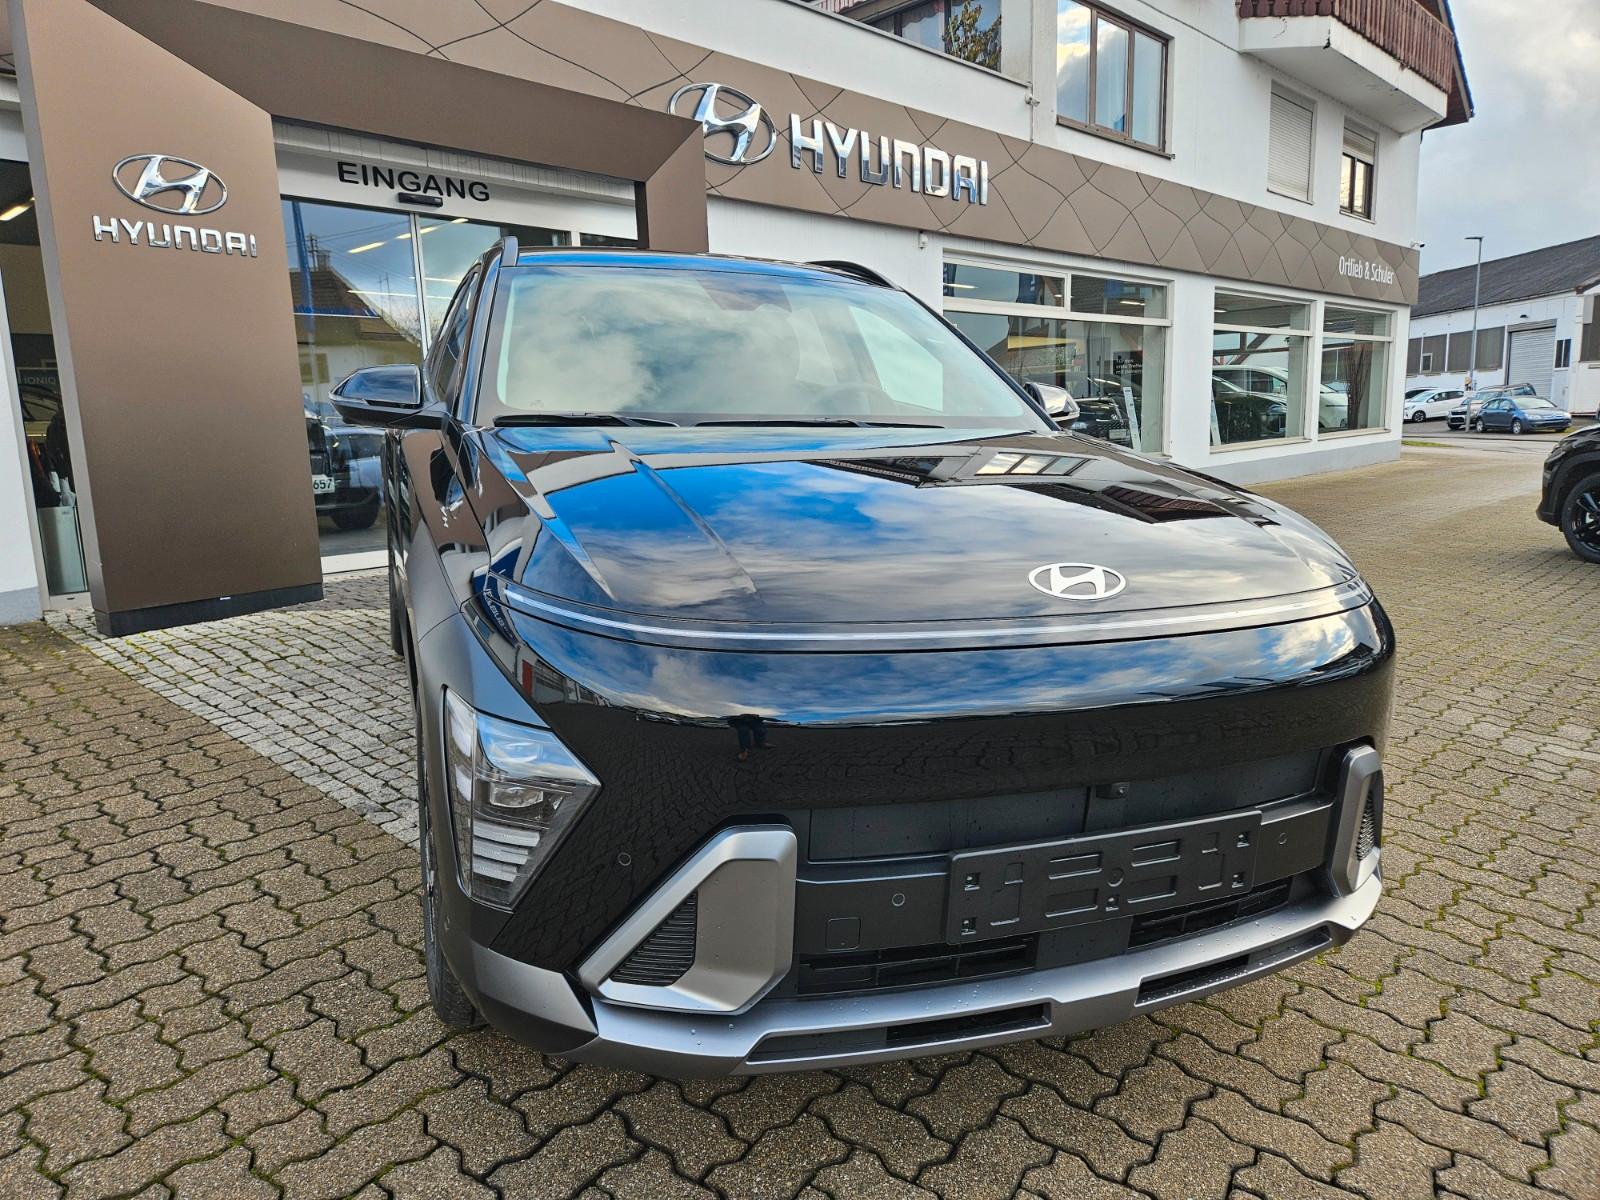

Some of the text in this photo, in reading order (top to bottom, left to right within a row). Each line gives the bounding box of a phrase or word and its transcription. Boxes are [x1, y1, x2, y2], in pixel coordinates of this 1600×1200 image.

[789, 112, 989, 206] HYUNDAI
[337, 161, 490, 202] EINGANG
[92, 215, 258, 258] HYUNDAI
[1338, 255, 1363, 279] Ortlieb
[1364, 261, 1370, 281] &
[313, 478, 332, 490] 657
